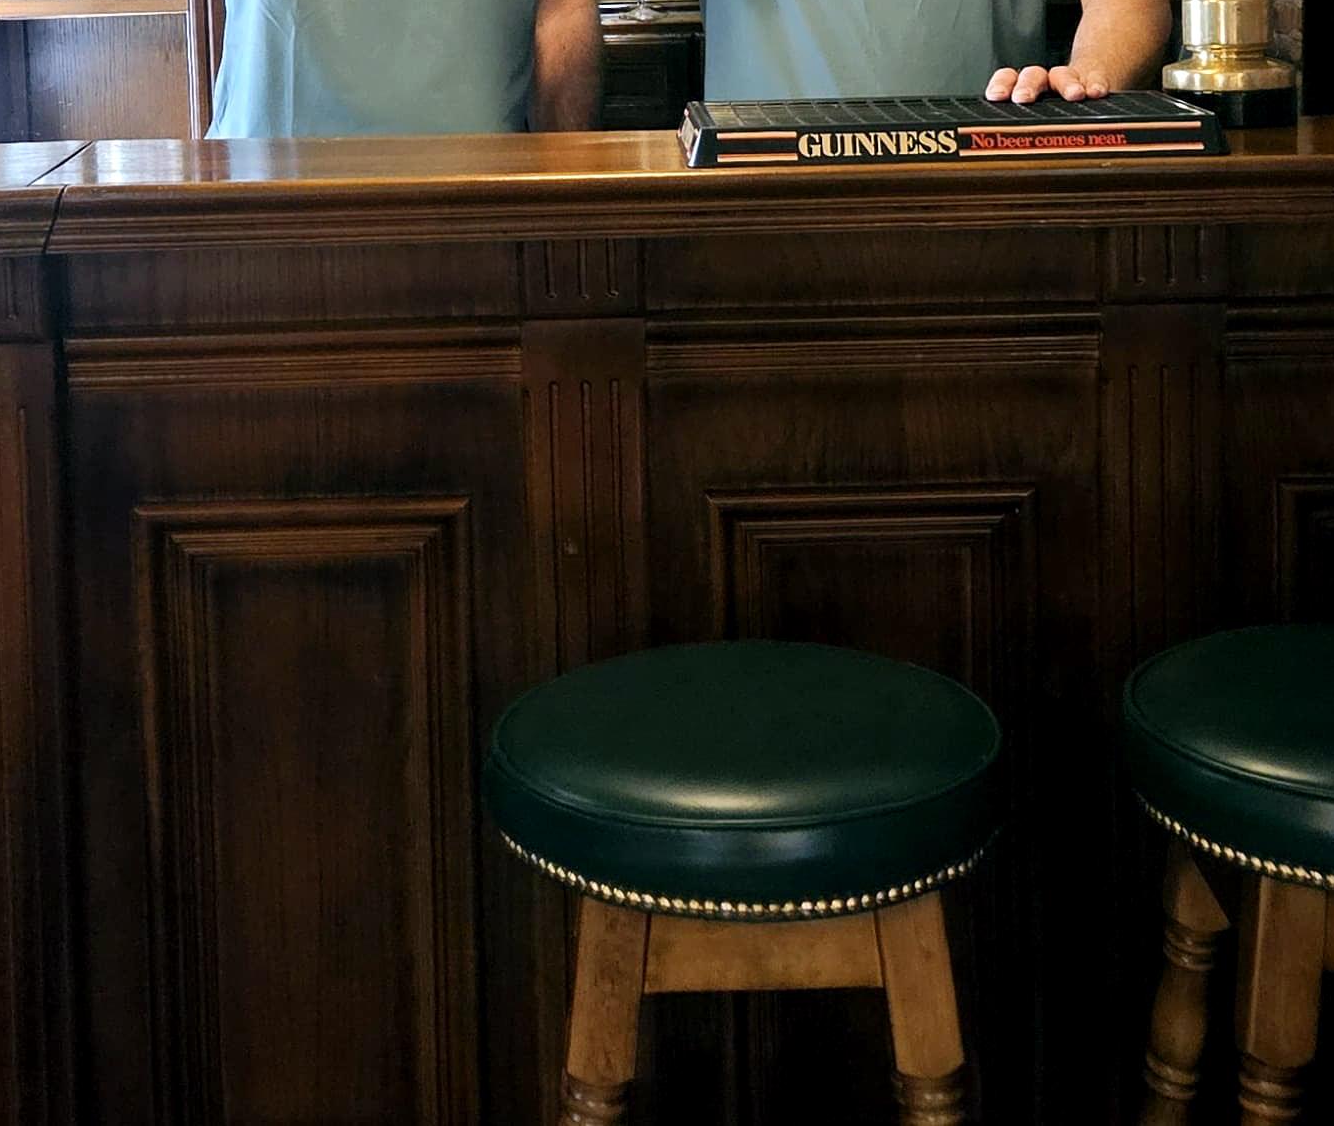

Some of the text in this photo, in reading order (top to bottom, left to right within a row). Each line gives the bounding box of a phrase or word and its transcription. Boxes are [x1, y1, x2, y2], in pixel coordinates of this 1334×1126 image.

[798, 129, 1127, 158] GUINNESS No beer comes near.
